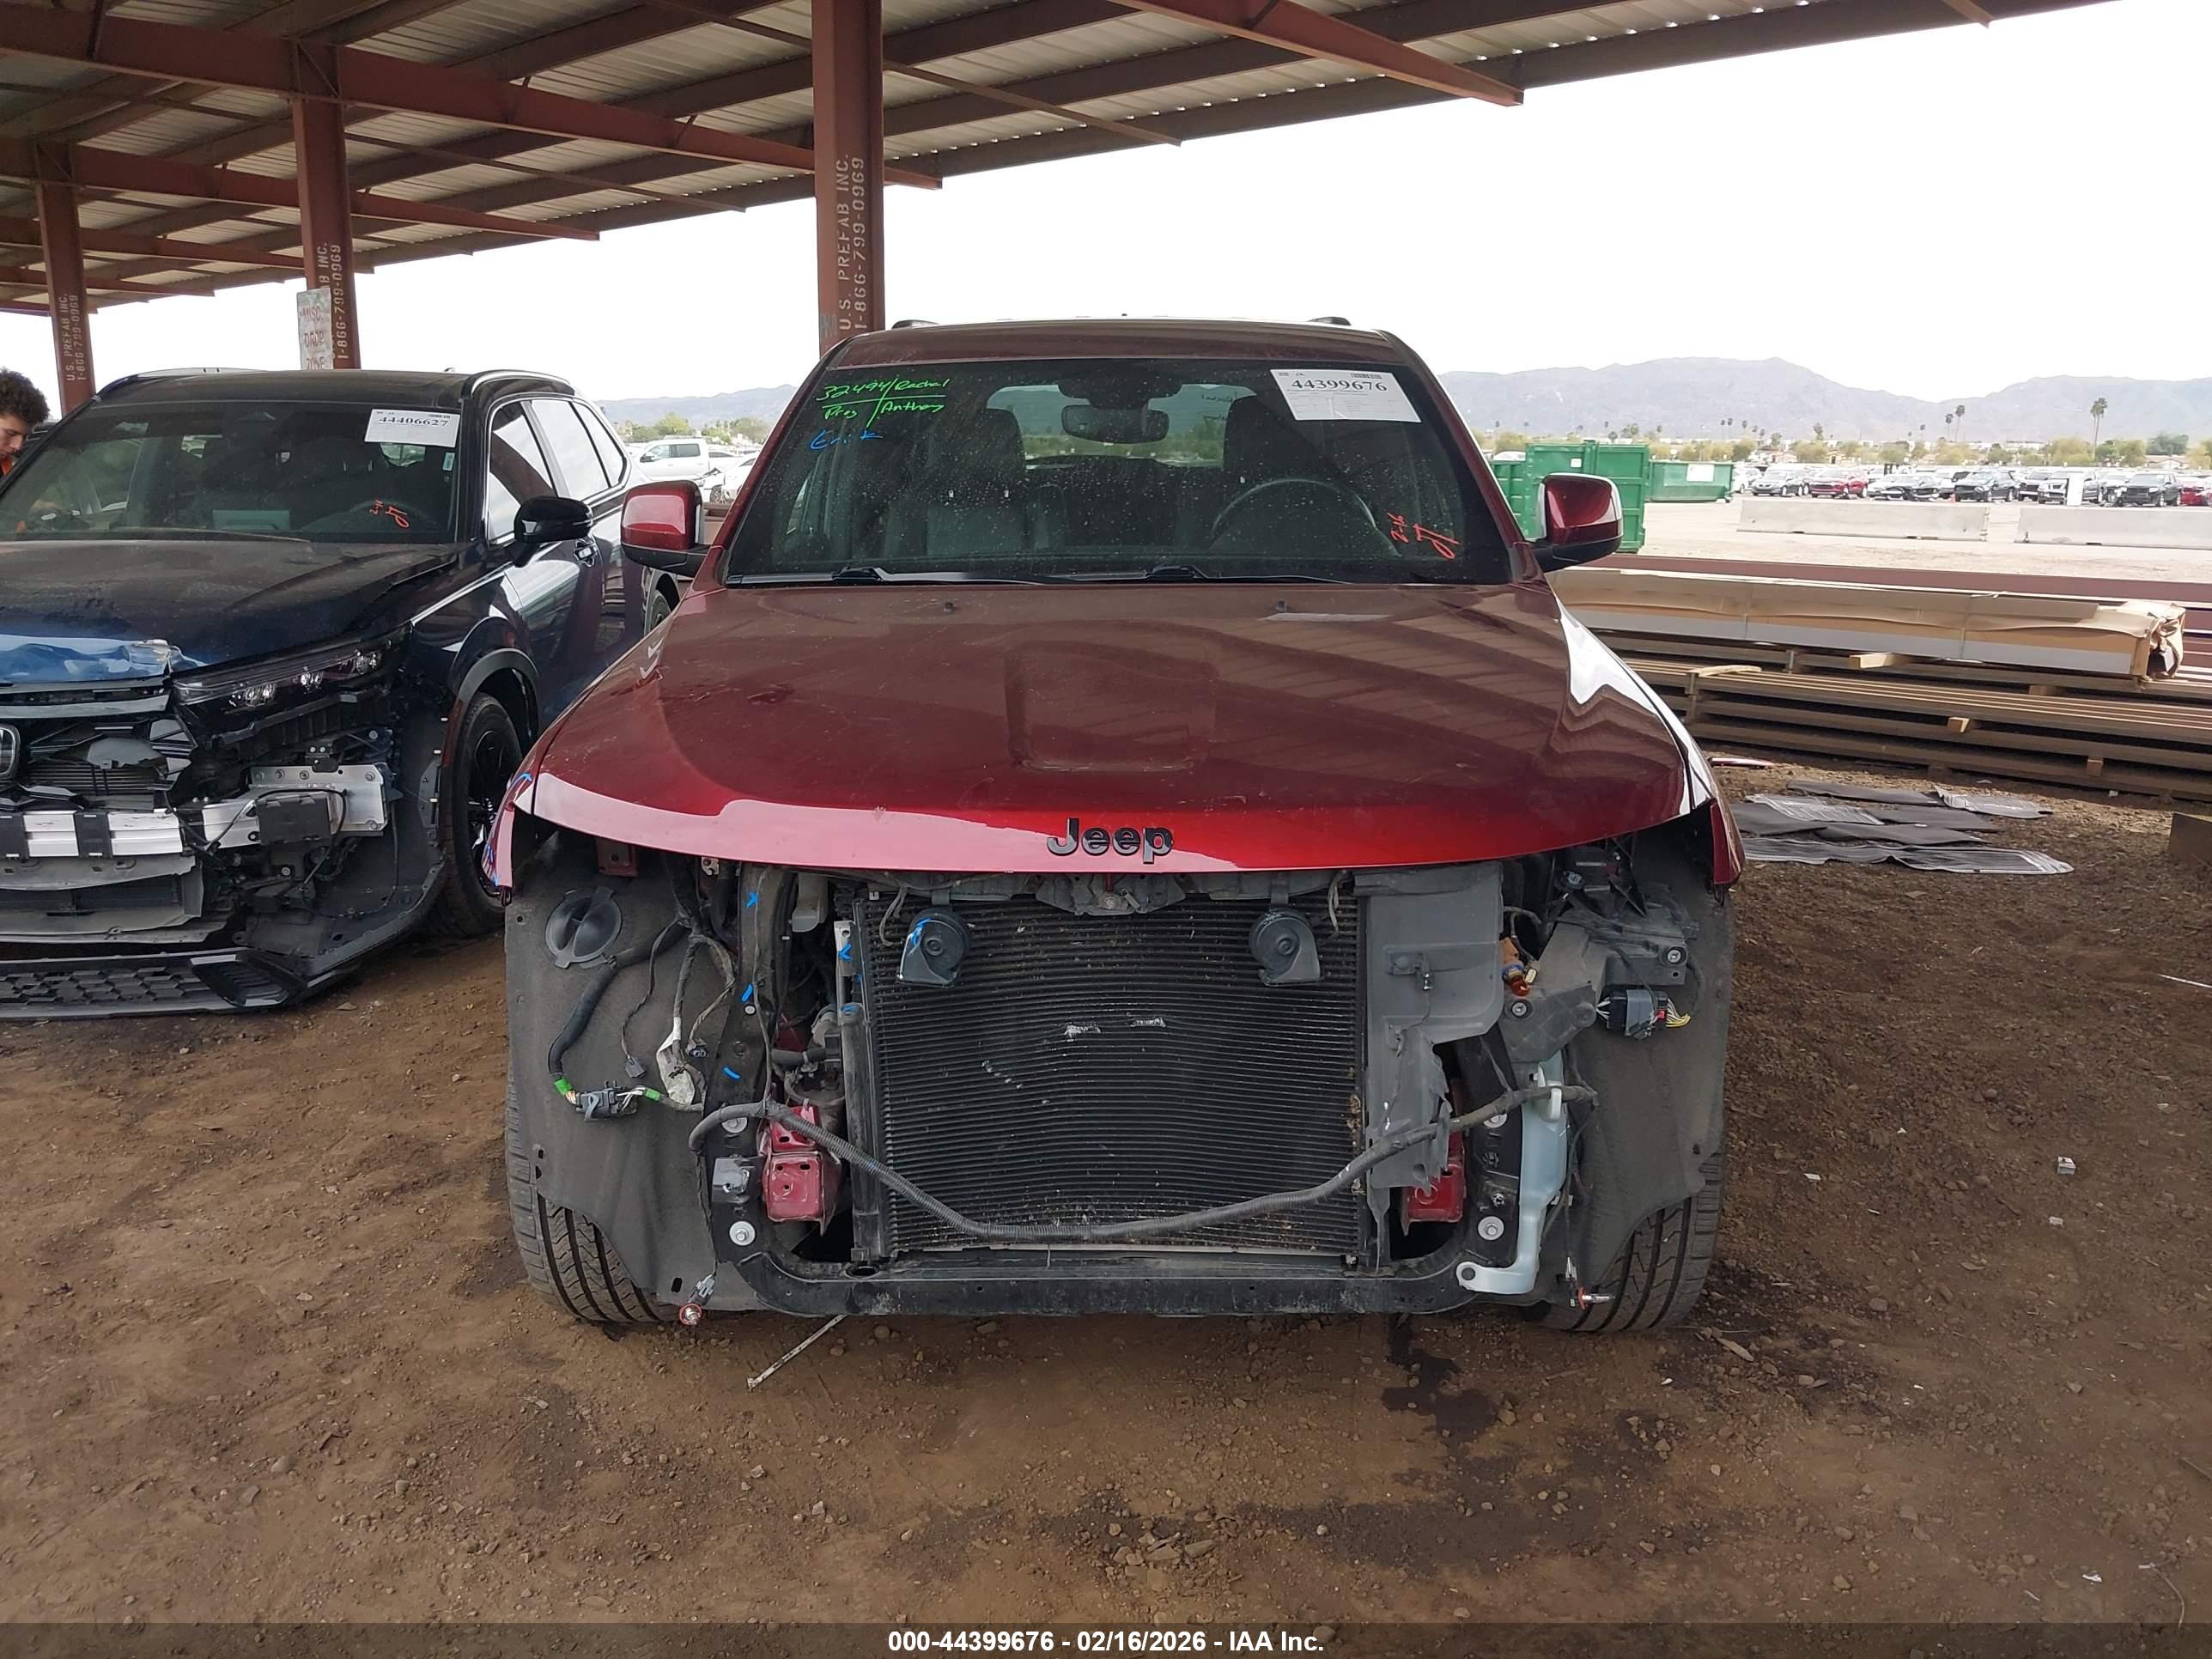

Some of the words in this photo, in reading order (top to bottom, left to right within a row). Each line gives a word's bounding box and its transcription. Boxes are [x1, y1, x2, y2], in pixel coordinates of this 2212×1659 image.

[836, 154, 849, 191] INC.
[317, 242, 329, 268] INC.
[836, 203, 850, 281] PREFAB
[851, 157, 867, 329] 1-866-799-0969
[58, 293, 68, 313] INC.
[839, 294, 852, 331] U.S.
[61, 318, 73, 356] PREFAB
[1291, 380, 1388, 392] 44399676
[380, 416, 448, 426] 44406627
[1047, 817, 1174, 865] Jeep
